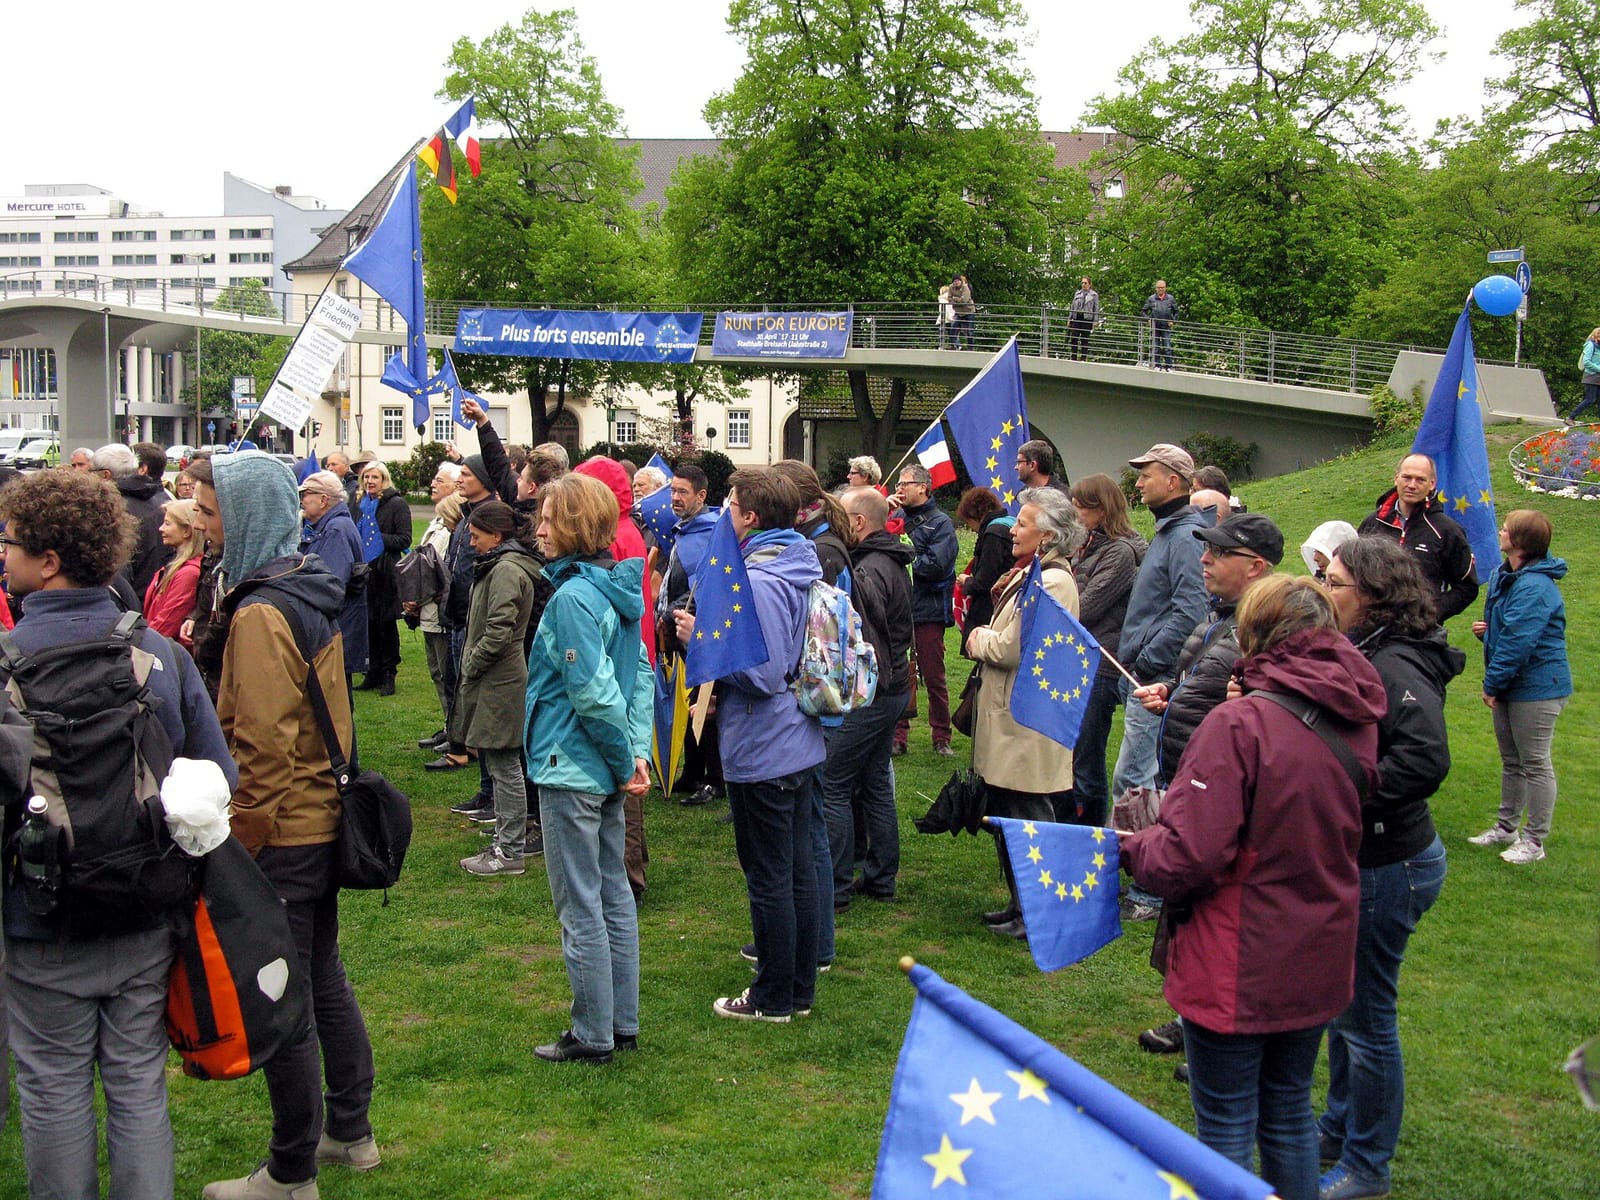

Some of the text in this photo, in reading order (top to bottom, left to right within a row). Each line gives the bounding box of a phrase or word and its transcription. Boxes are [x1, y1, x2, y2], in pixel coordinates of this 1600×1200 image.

[7, 203, 54, 211] Mercure
[319, 306, 352, 332] Frieden
[323, 295, 360, 322] 70 Jahre
[500, 324, 645, 347] Plus forts ensemble
[724, 317, 847, 331] RUN FOR EUROPE
